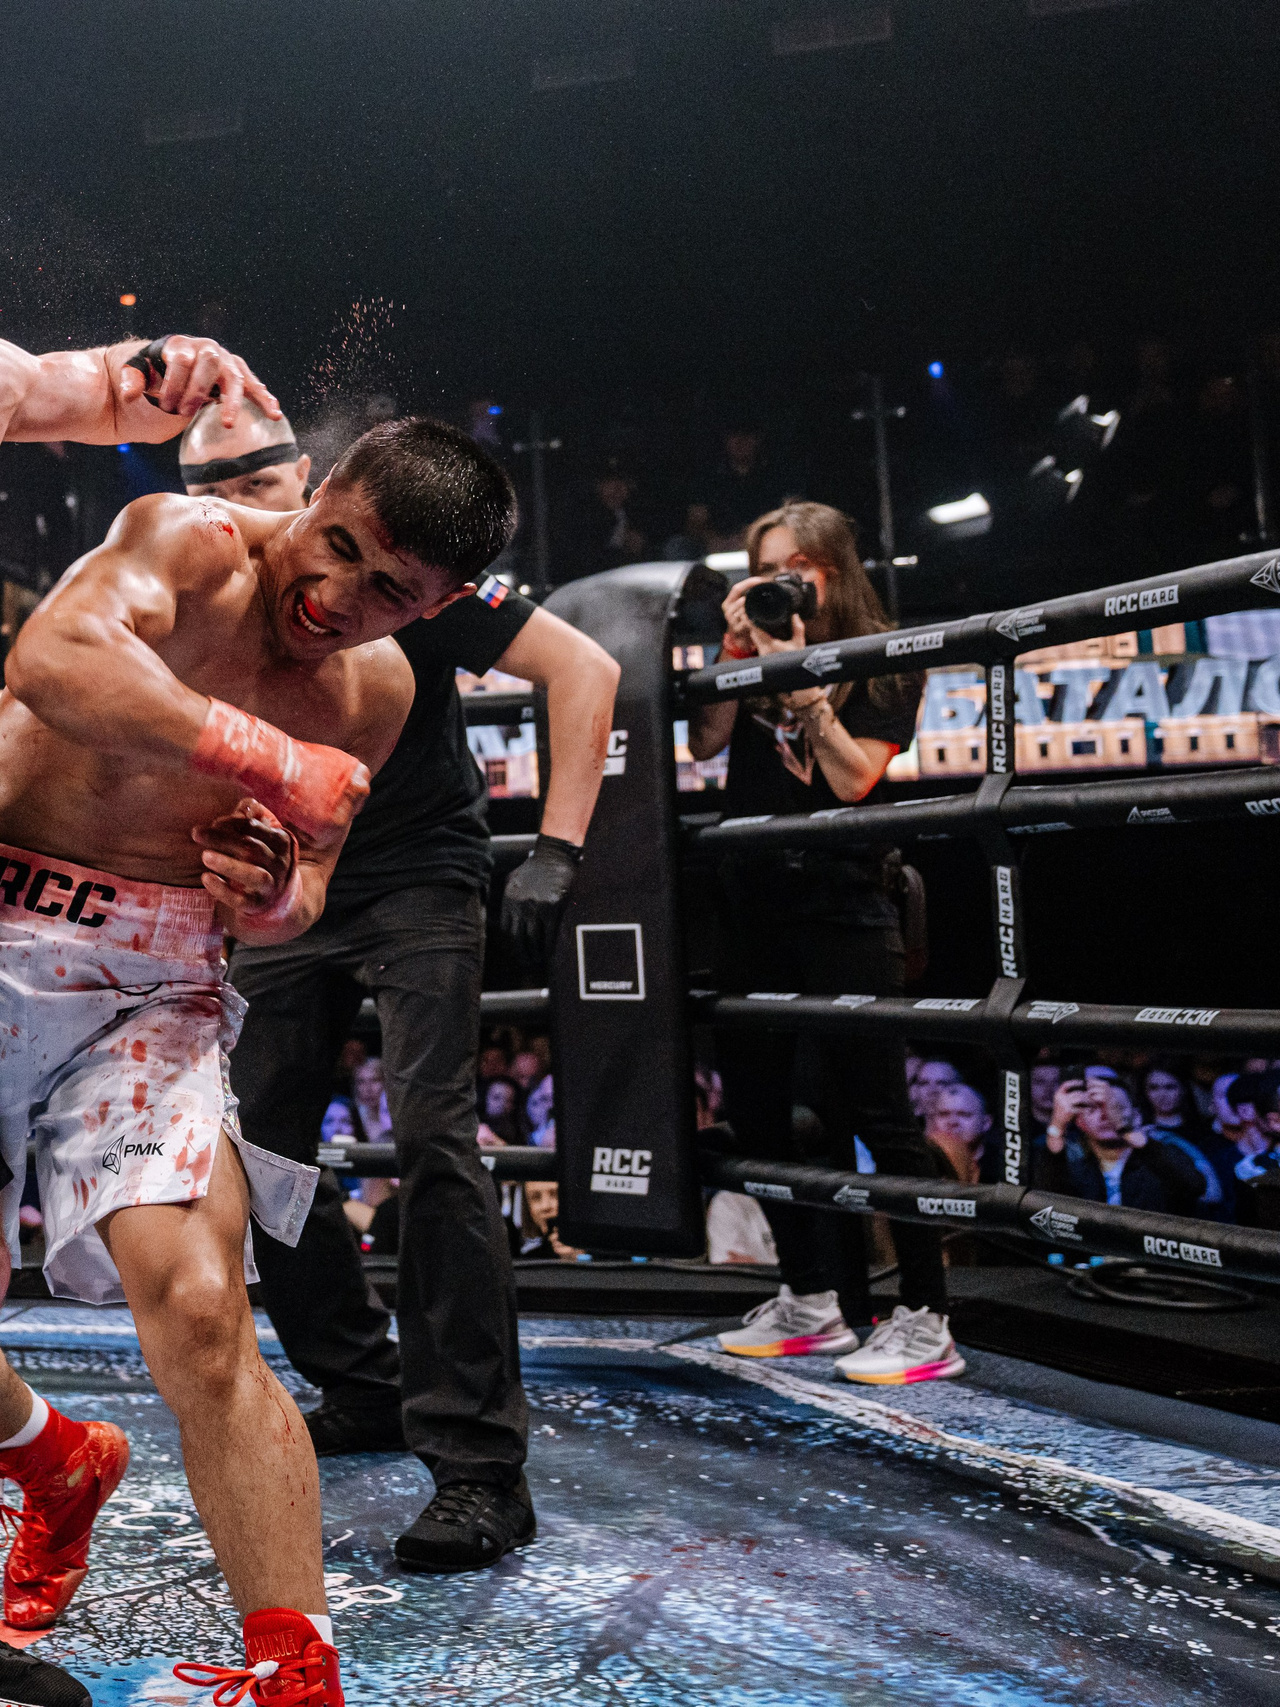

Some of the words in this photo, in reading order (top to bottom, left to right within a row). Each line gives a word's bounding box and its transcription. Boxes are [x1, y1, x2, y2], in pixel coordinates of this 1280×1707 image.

[1104, 596, 1139, 617] RCC
[992, 721, 1006, 773] RCC
[999, 925, 1018, 978] RCC
[124, 1142, 165, 1158] PMK
[593, 1147, 652, 1176] RCC
[1006, 1131, 1021, 1186] RCC
[1144, 1235, 1179, 1259] RCC
